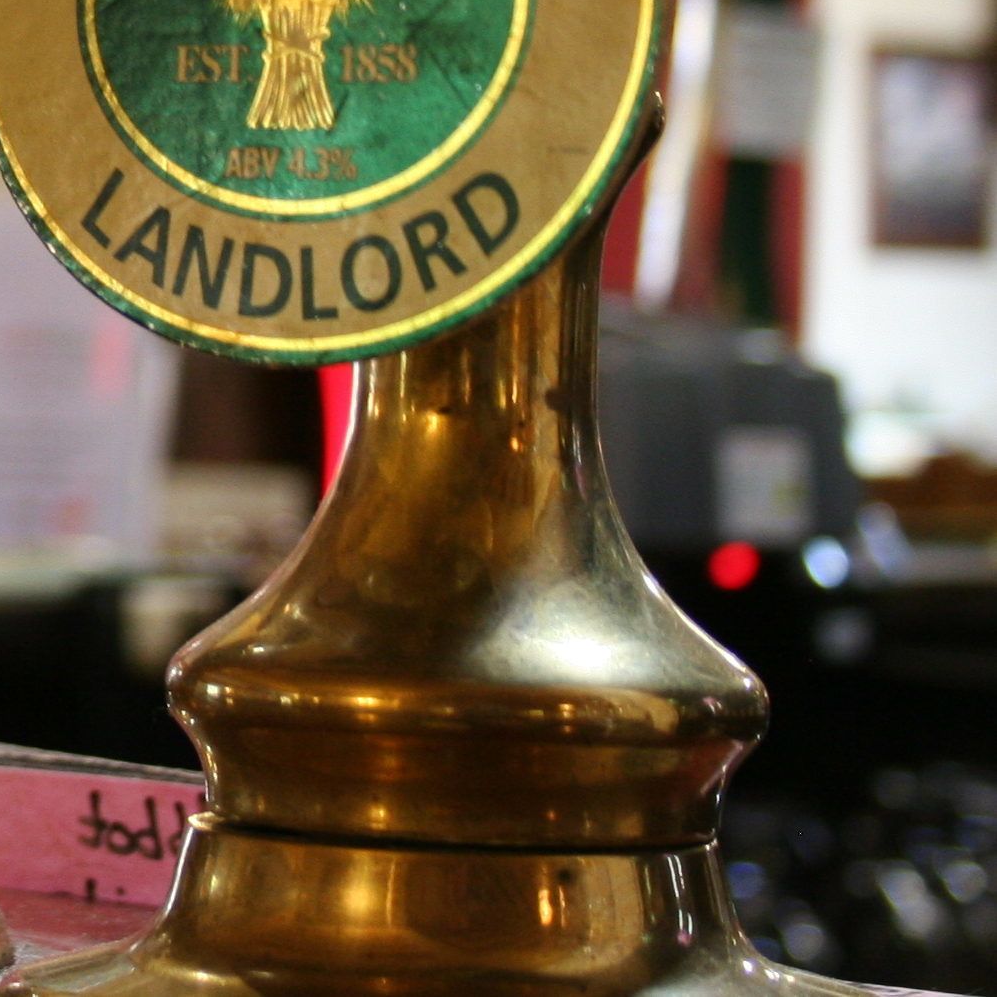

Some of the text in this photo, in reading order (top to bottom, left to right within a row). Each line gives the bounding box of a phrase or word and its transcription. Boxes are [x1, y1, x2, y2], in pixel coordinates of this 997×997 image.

[340, 44, 419, 84] 1858
[224, 147, 359, 180] ABV 4.3%
[79, 169, 521, 322] LANDLORD
